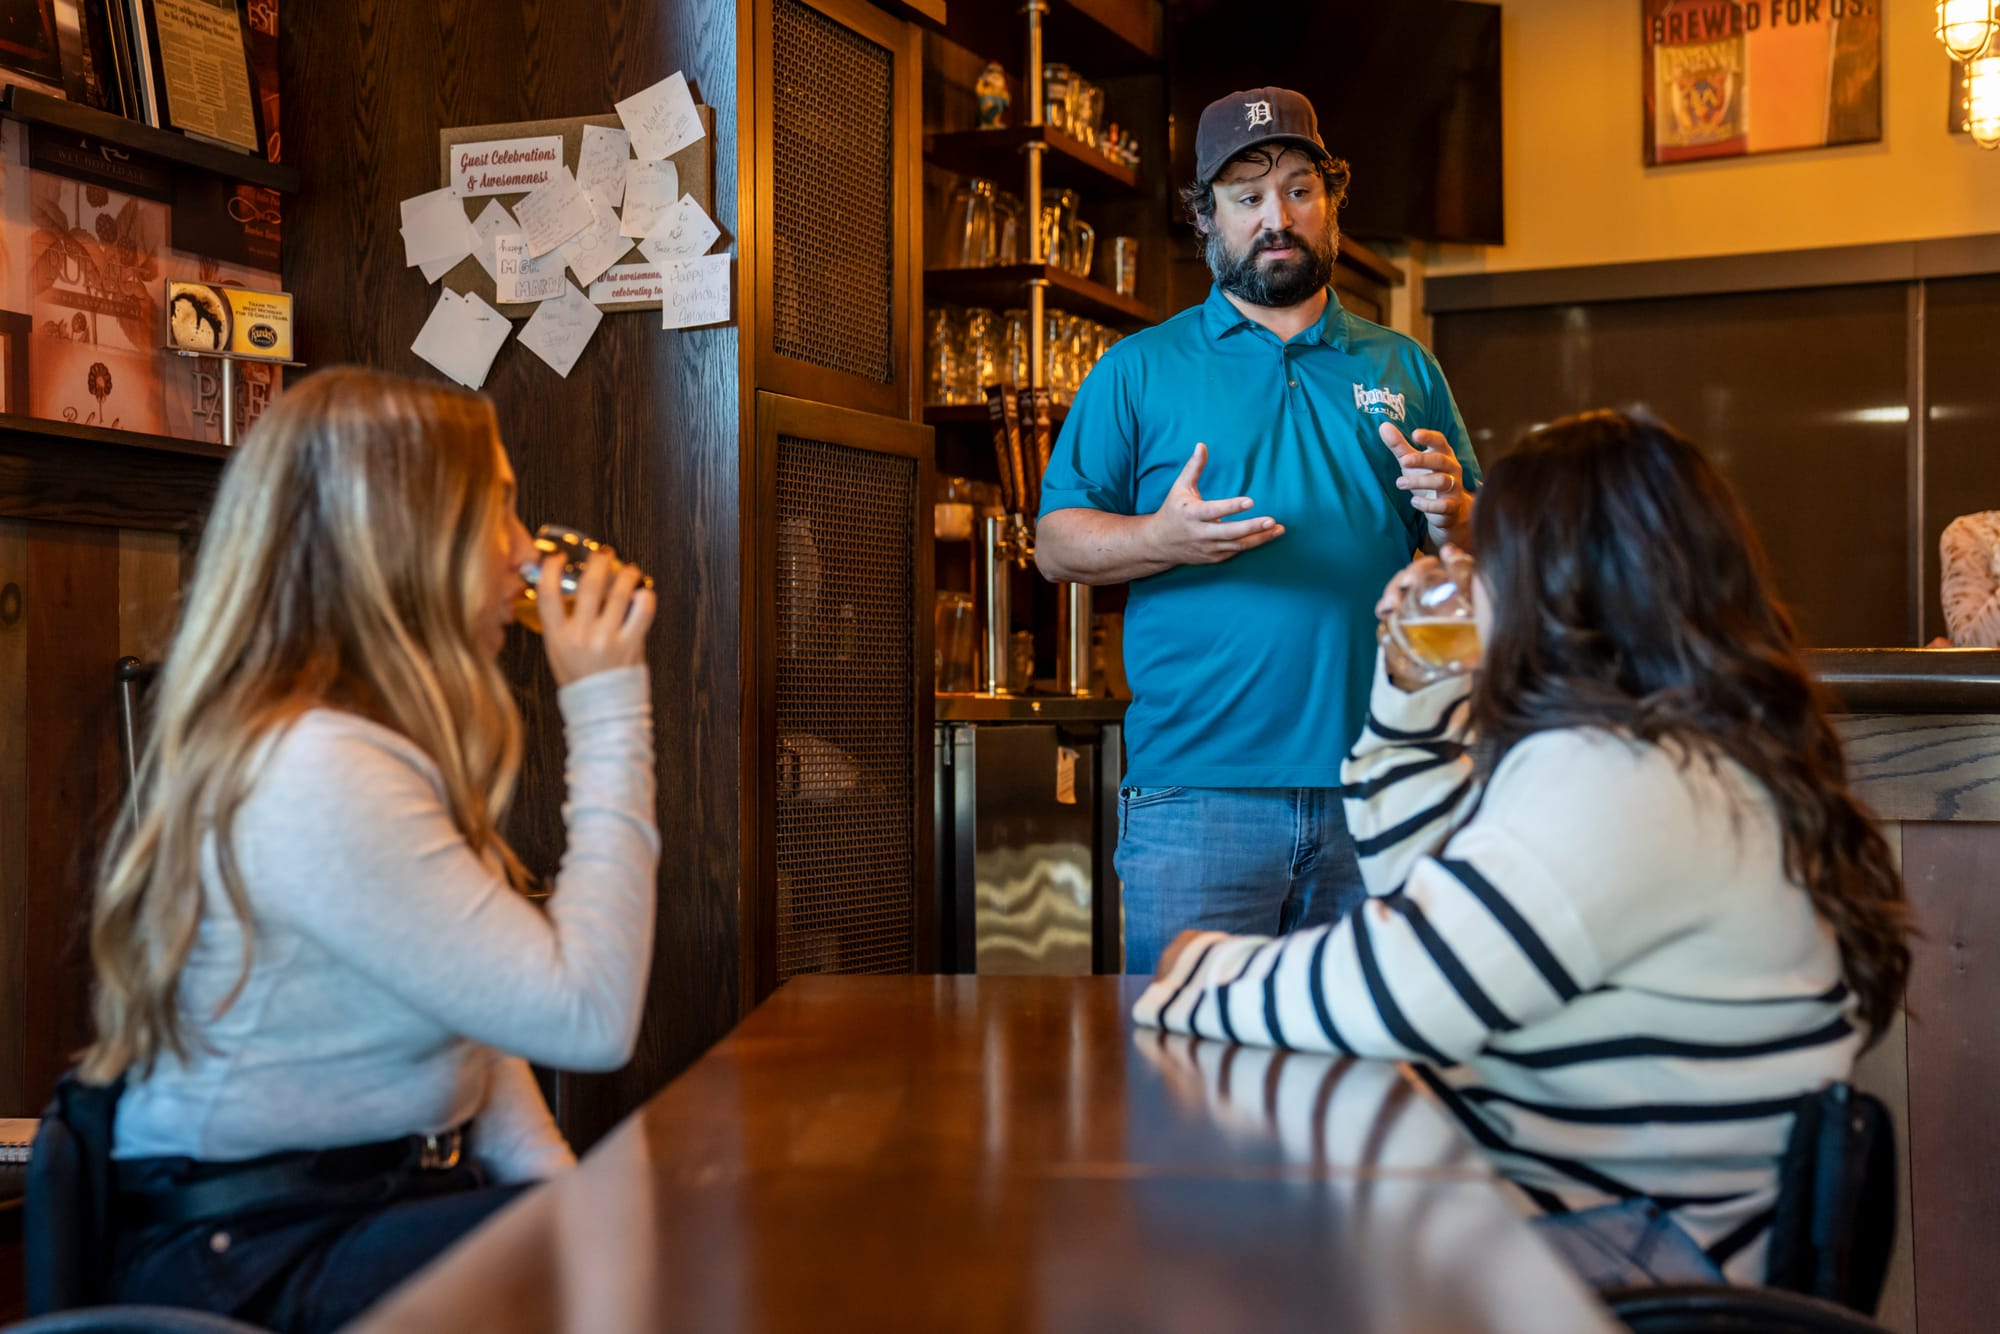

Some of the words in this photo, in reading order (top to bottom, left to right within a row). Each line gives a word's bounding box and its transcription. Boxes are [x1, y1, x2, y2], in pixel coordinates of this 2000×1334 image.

[1652, 2, 1760, 44] BREWED
[1771, 0, 1819, 27] FOR
[1244, 100, 1273, 131] D
[460, 152, 489, 174] Guest
[491, 147, 556, 166] Celebrations
[467, 175, 478, 192] &
[479, 171, 548, 189] Awesomeness
[611, 286, 653, 298] celebrating
